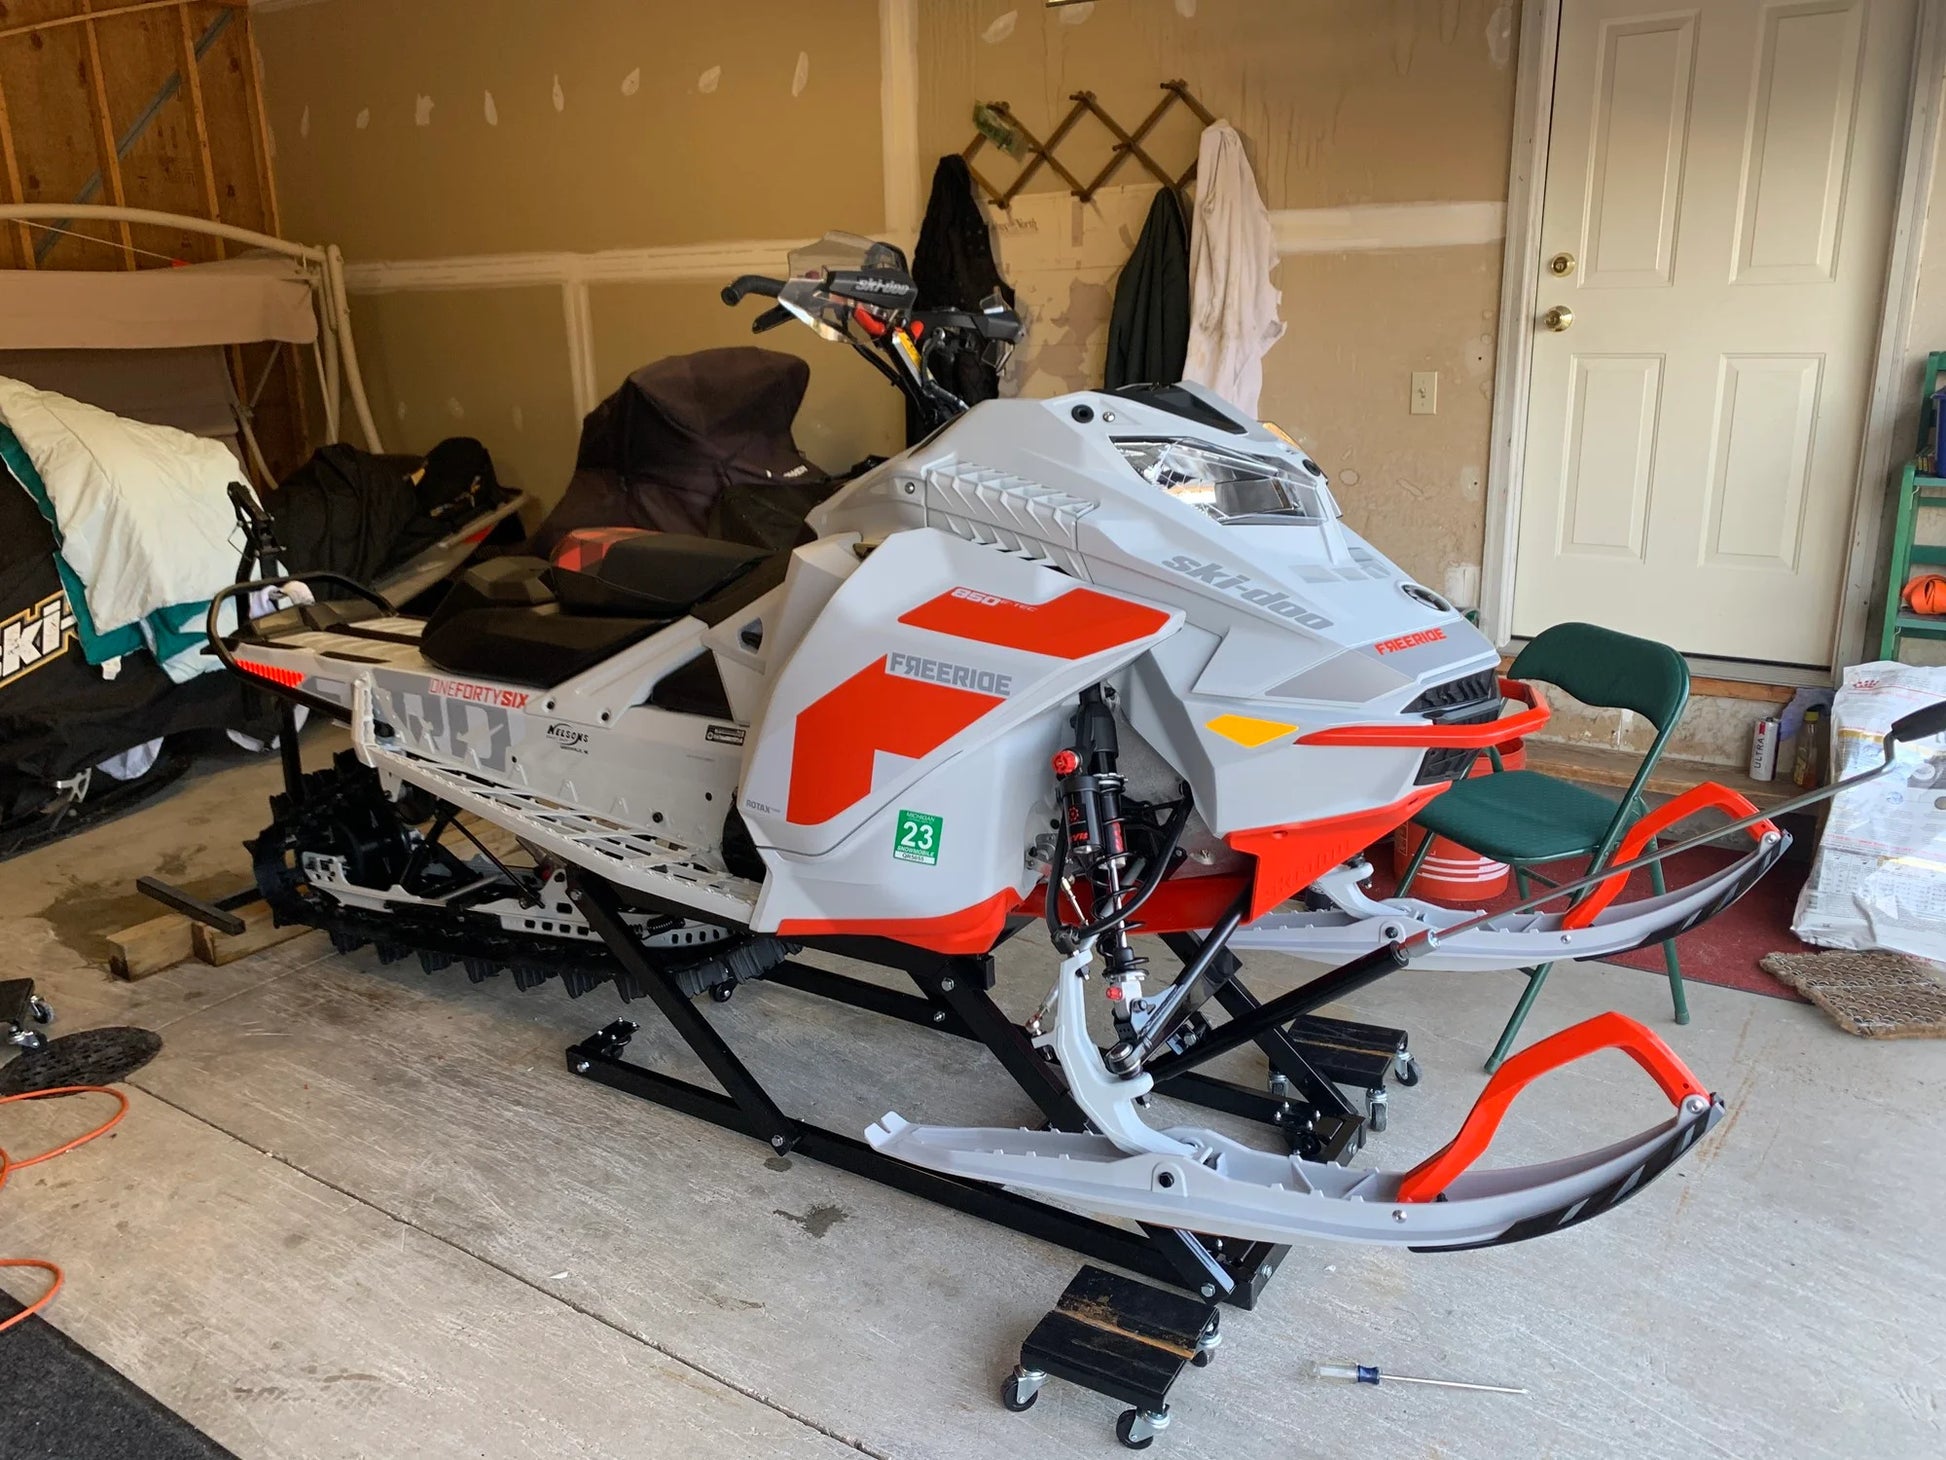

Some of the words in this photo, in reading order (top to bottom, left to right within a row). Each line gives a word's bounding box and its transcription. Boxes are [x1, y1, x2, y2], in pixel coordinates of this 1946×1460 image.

[951, 587, 1001, 608] 850
[1161, 555, 1334, 631] ski-doo
[1374, 627, 1447, 655] FREERIDE
[889, 651, 1012, 697] FREERIDE
[430, 678, 529, 709] ONEFORTYSIX
[1753, 737, 1765, 769] ULTRA
[745, 799, 770, 814] ROTAX
[900, 821, 934, 850] 23
